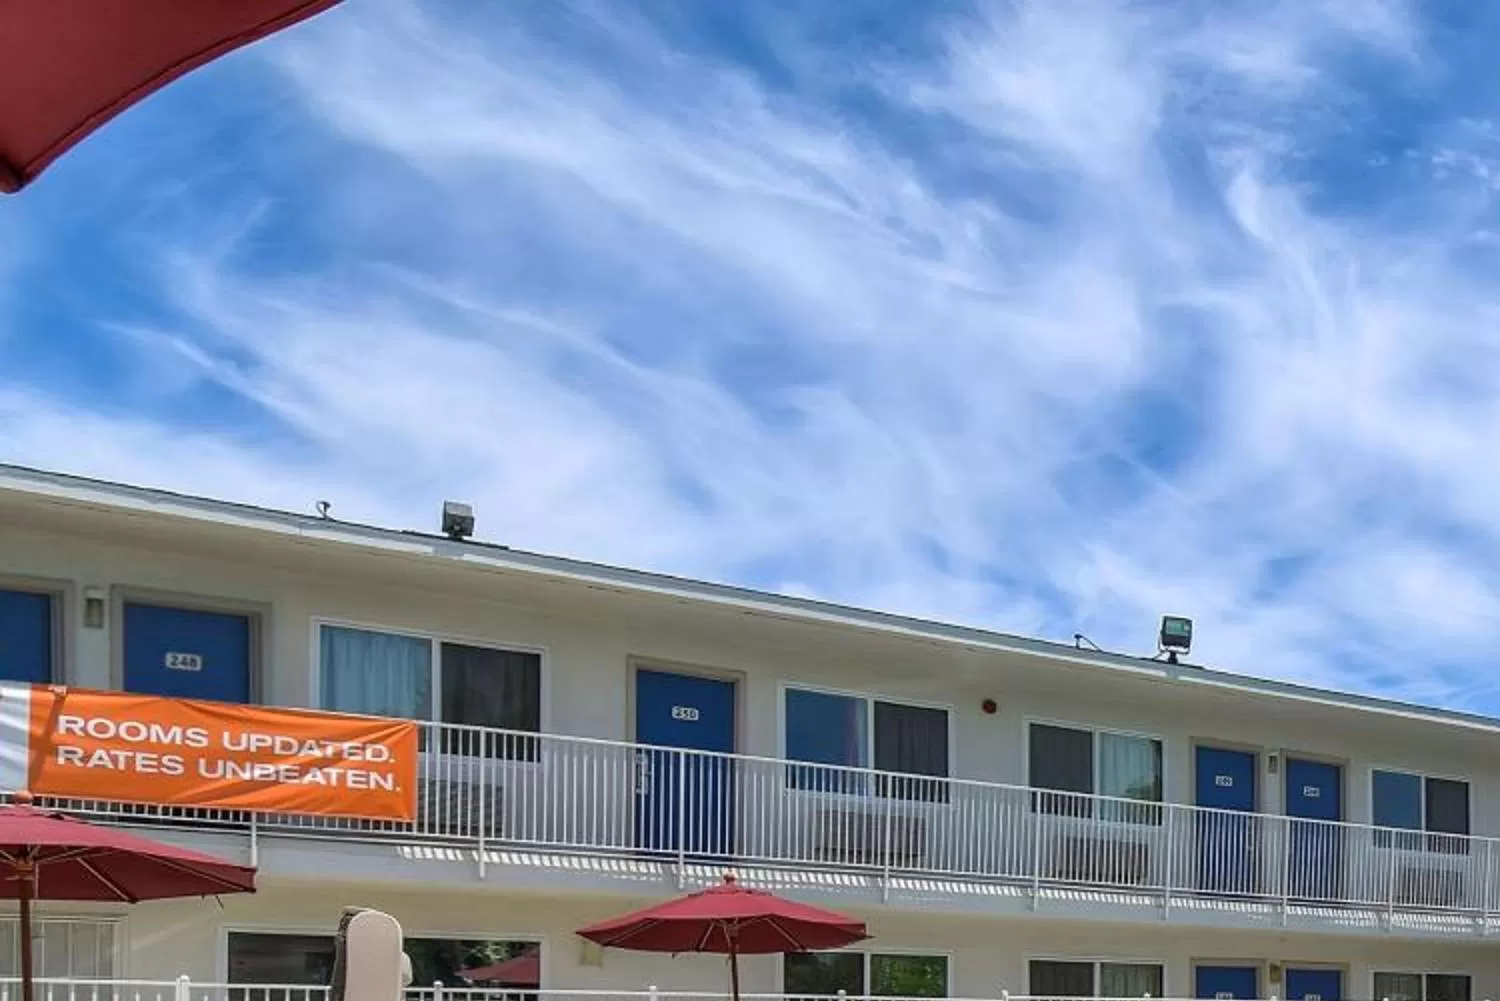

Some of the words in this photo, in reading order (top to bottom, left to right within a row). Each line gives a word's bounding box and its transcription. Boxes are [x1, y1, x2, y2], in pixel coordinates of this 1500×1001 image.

[57, 714, 209, 748] ROOMS
[223, 731, 396, 764] UPDATED.
[56, 745, 185, 775] RATES
[198, 756, 401, 792] UNBEATEN.
